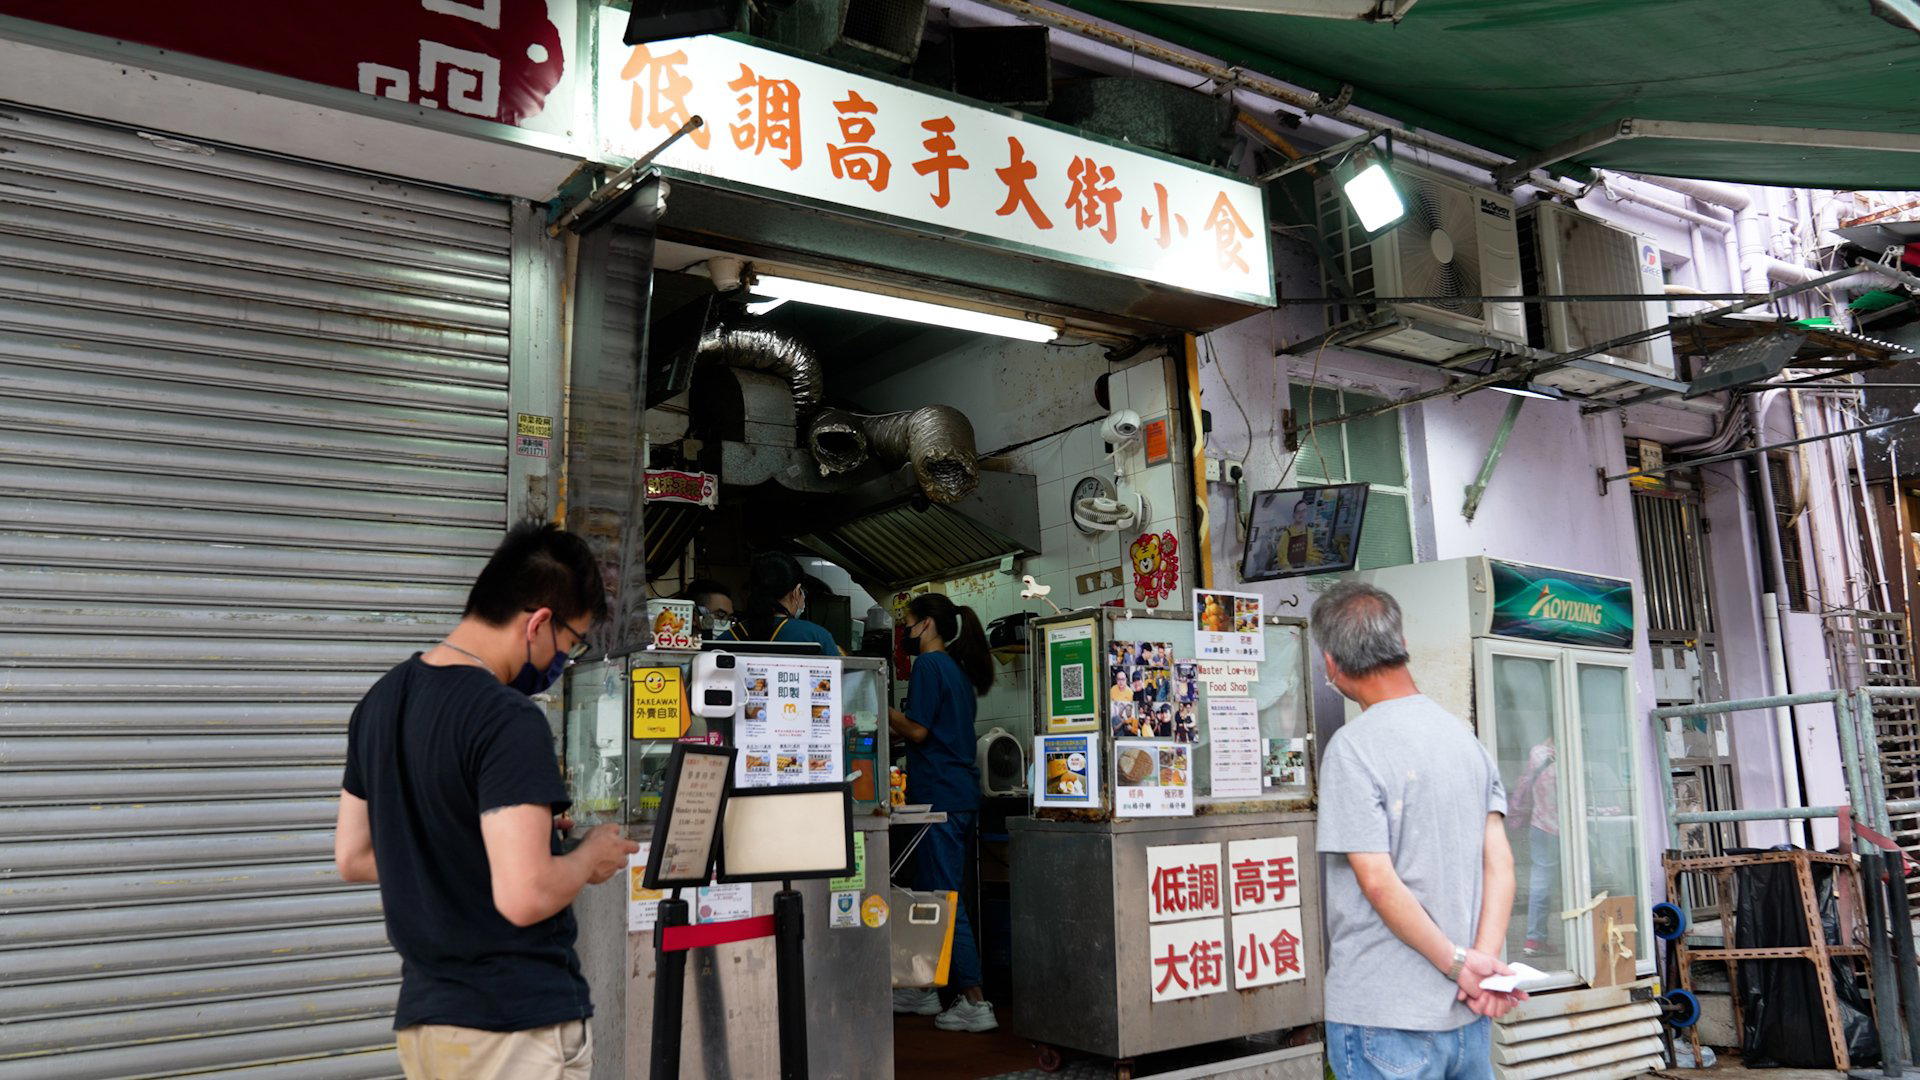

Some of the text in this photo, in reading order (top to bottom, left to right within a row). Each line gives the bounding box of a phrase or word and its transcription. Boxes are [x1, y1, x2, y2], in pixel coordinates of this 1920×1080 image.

[620, 44, 1254, 275] 低調高手大街小食
[778, 671, 800, 684] 即叫
[1209, 681, 1247, 692] Food Shop
[1151, 856, 1297, 915] 低調 高手
[1154, 928, 1301, 994] 大街 小食
